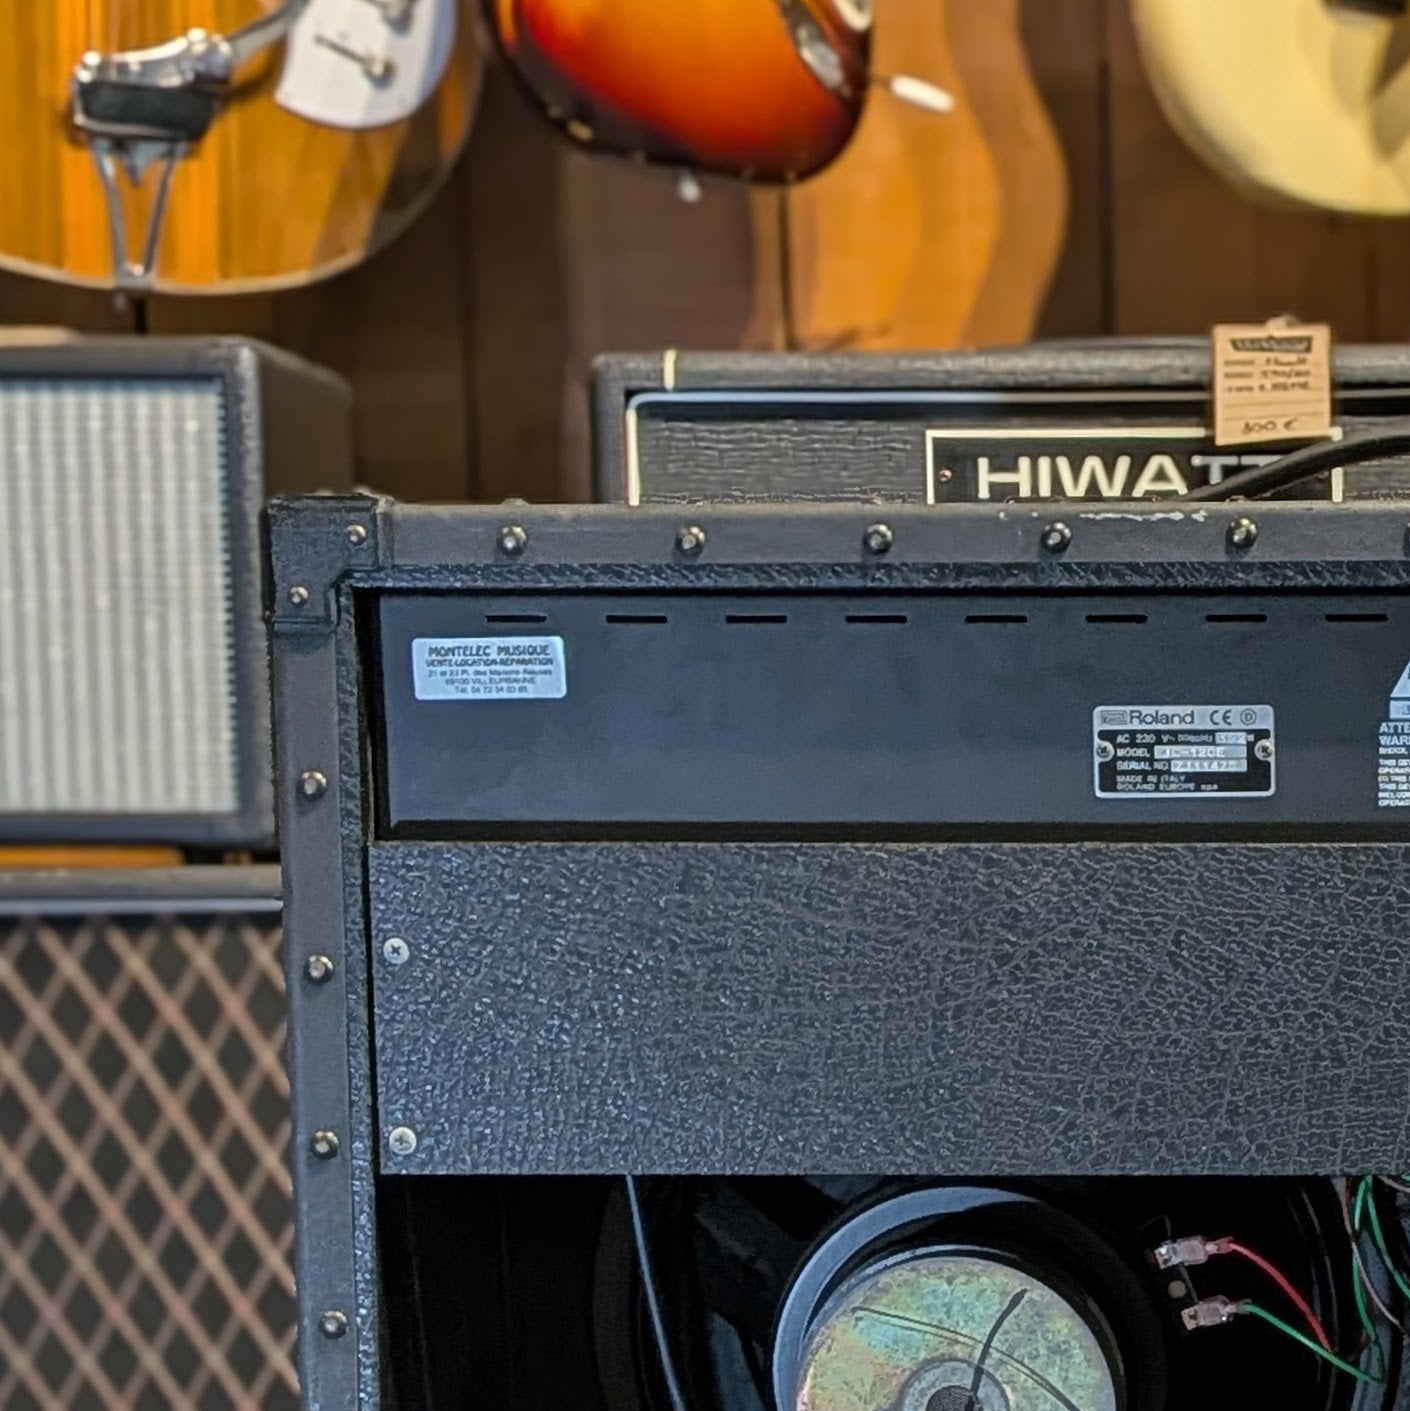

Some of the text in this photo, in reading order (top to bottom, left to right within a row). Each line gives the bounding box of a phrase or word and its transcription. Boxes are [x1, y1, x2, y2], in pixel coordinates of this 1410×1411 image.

[977, 455, 1284, 499] HIWAT
[428, 644, 550, 657] MONTELEC MUSIQUE
[1129, 709, 1195, 725] Roland
[1116, 733, 1130, 743] AC
[1116, 747, 1150, 758] MODEL
[1116, 760, 1152, 770] SERIAL
[1116, 775, 1186, 783] MADE IN ITALY
[1116, 782, 1155, 791] ROLAND
[1159, 782, 1195, 791] EUROPE
